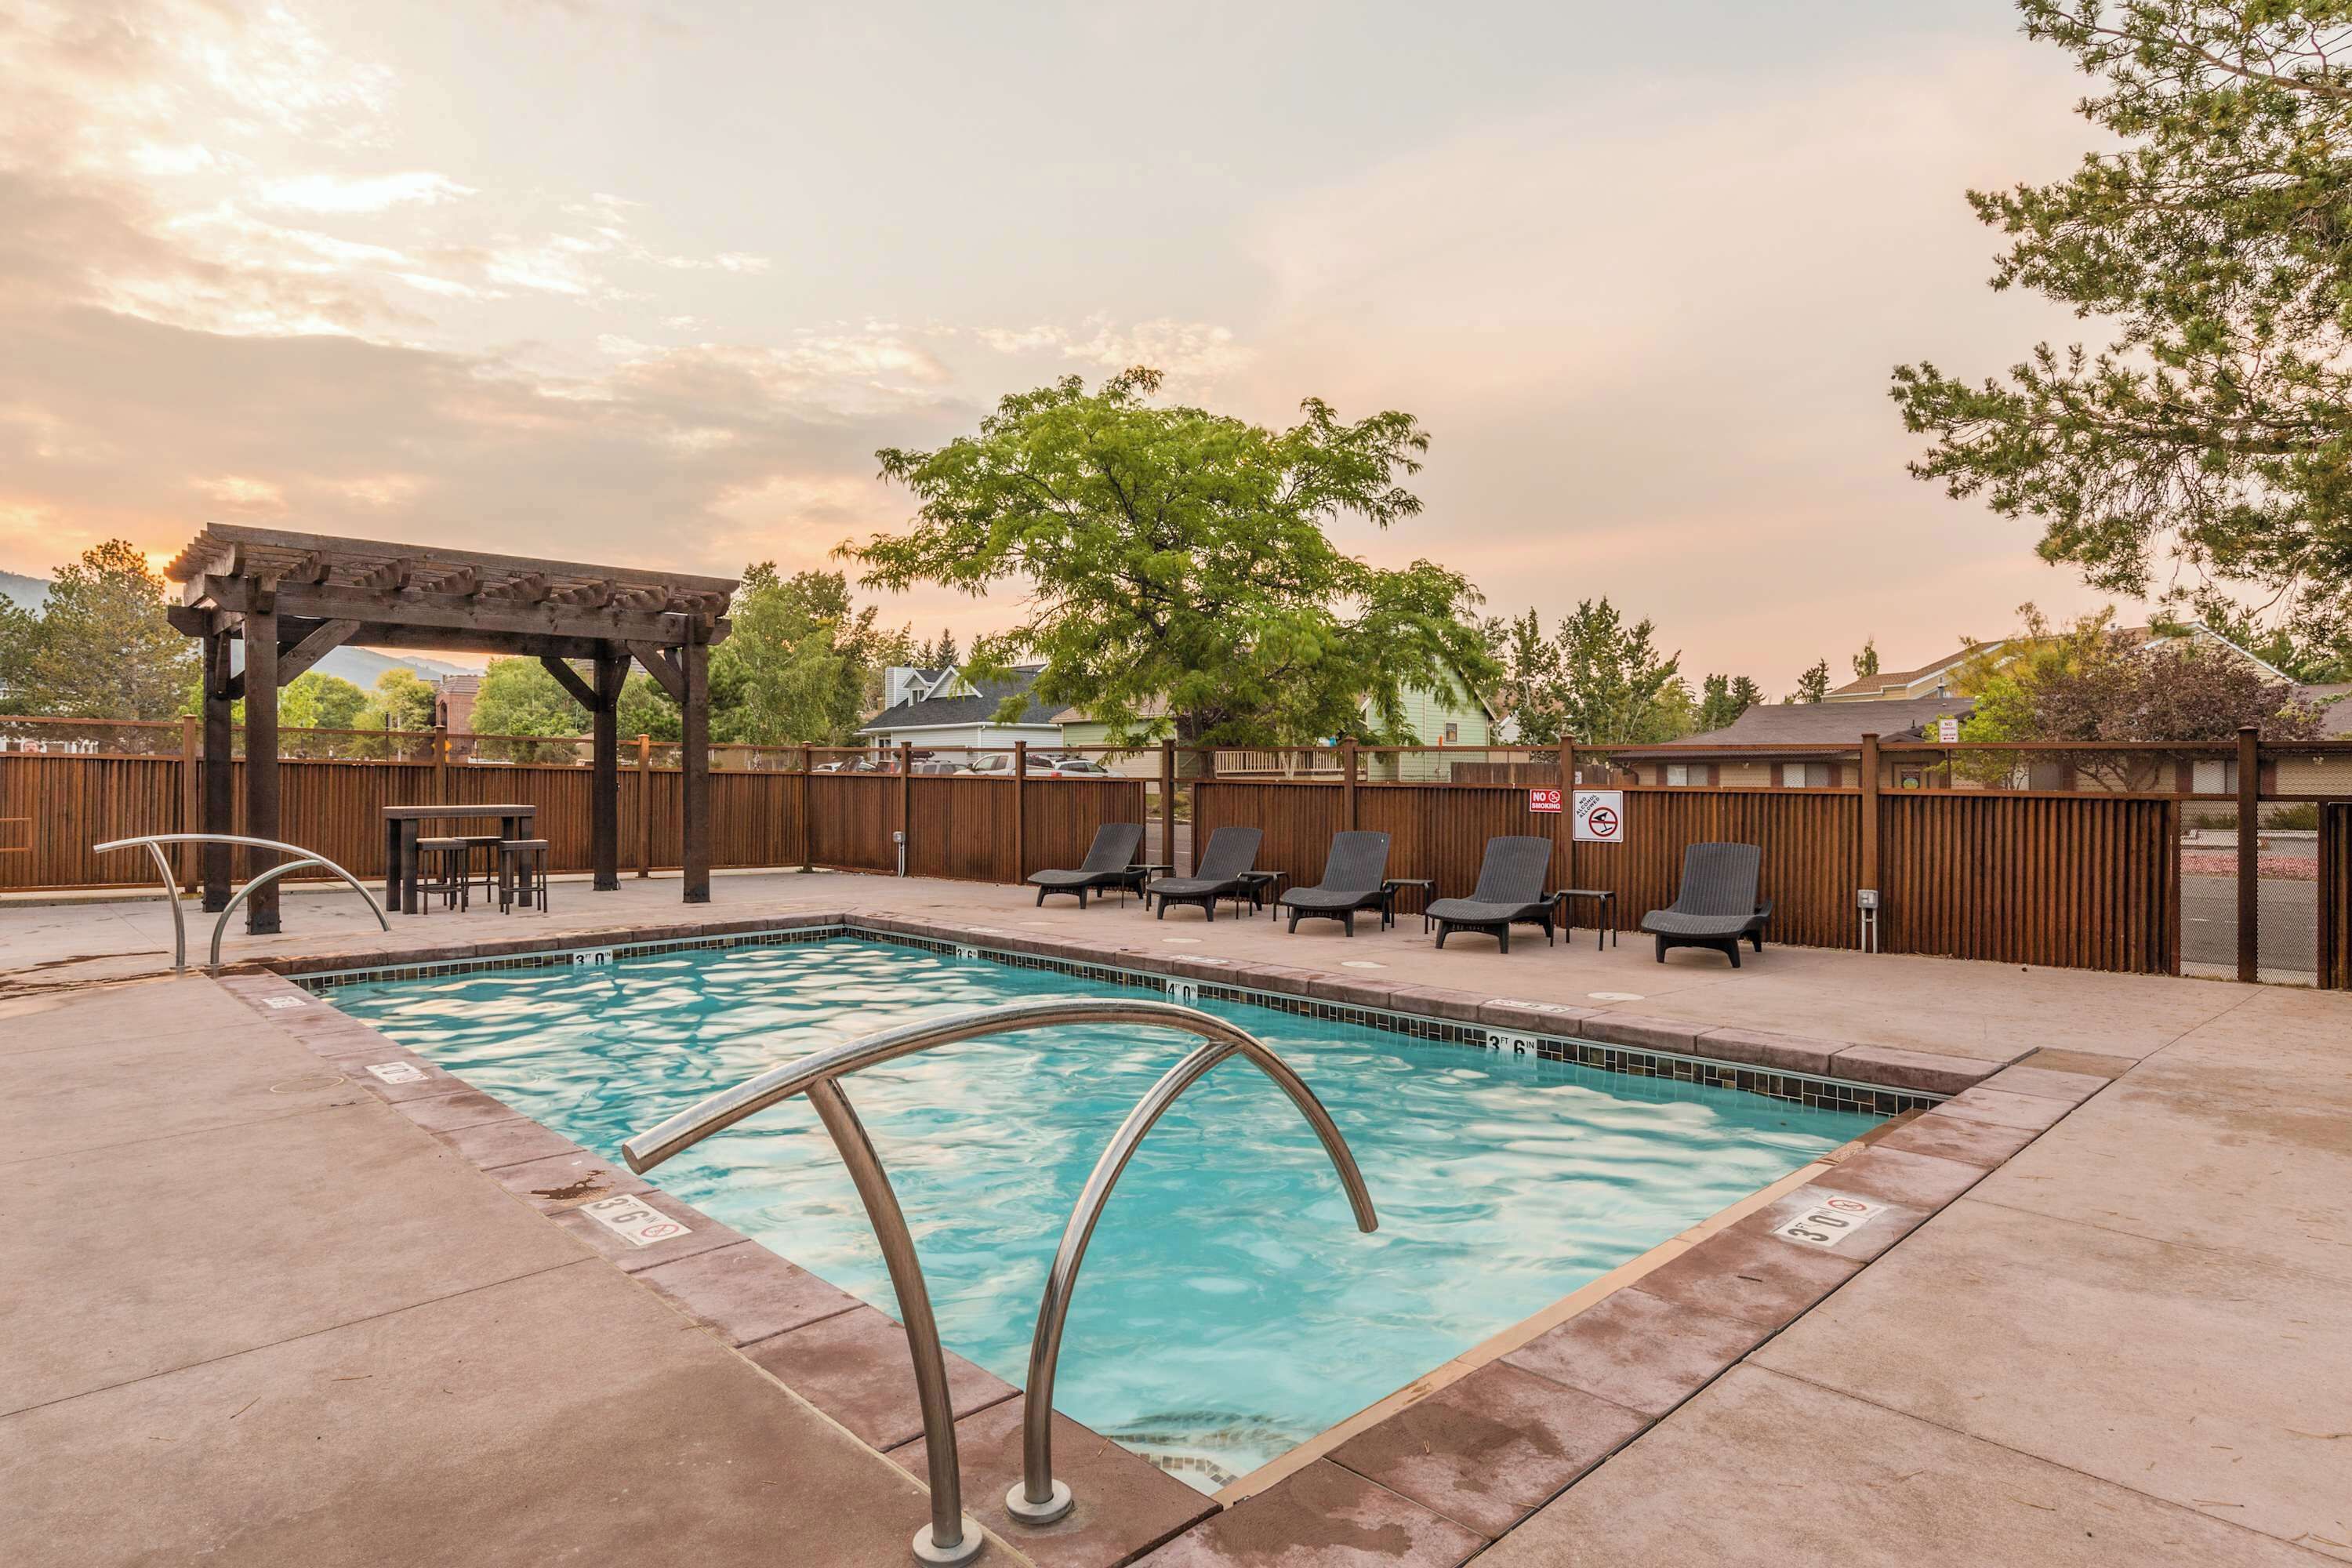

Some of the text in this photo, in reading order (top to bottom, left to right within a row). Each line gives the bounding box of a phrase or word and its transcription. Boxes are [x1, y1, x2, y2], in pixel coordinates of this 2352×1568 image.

[1533, 792, 1546, 801] NO
[1576, 794, 1596, 815] ALCOHOL
[1579, 797, 1600, 818] ALLOWED
